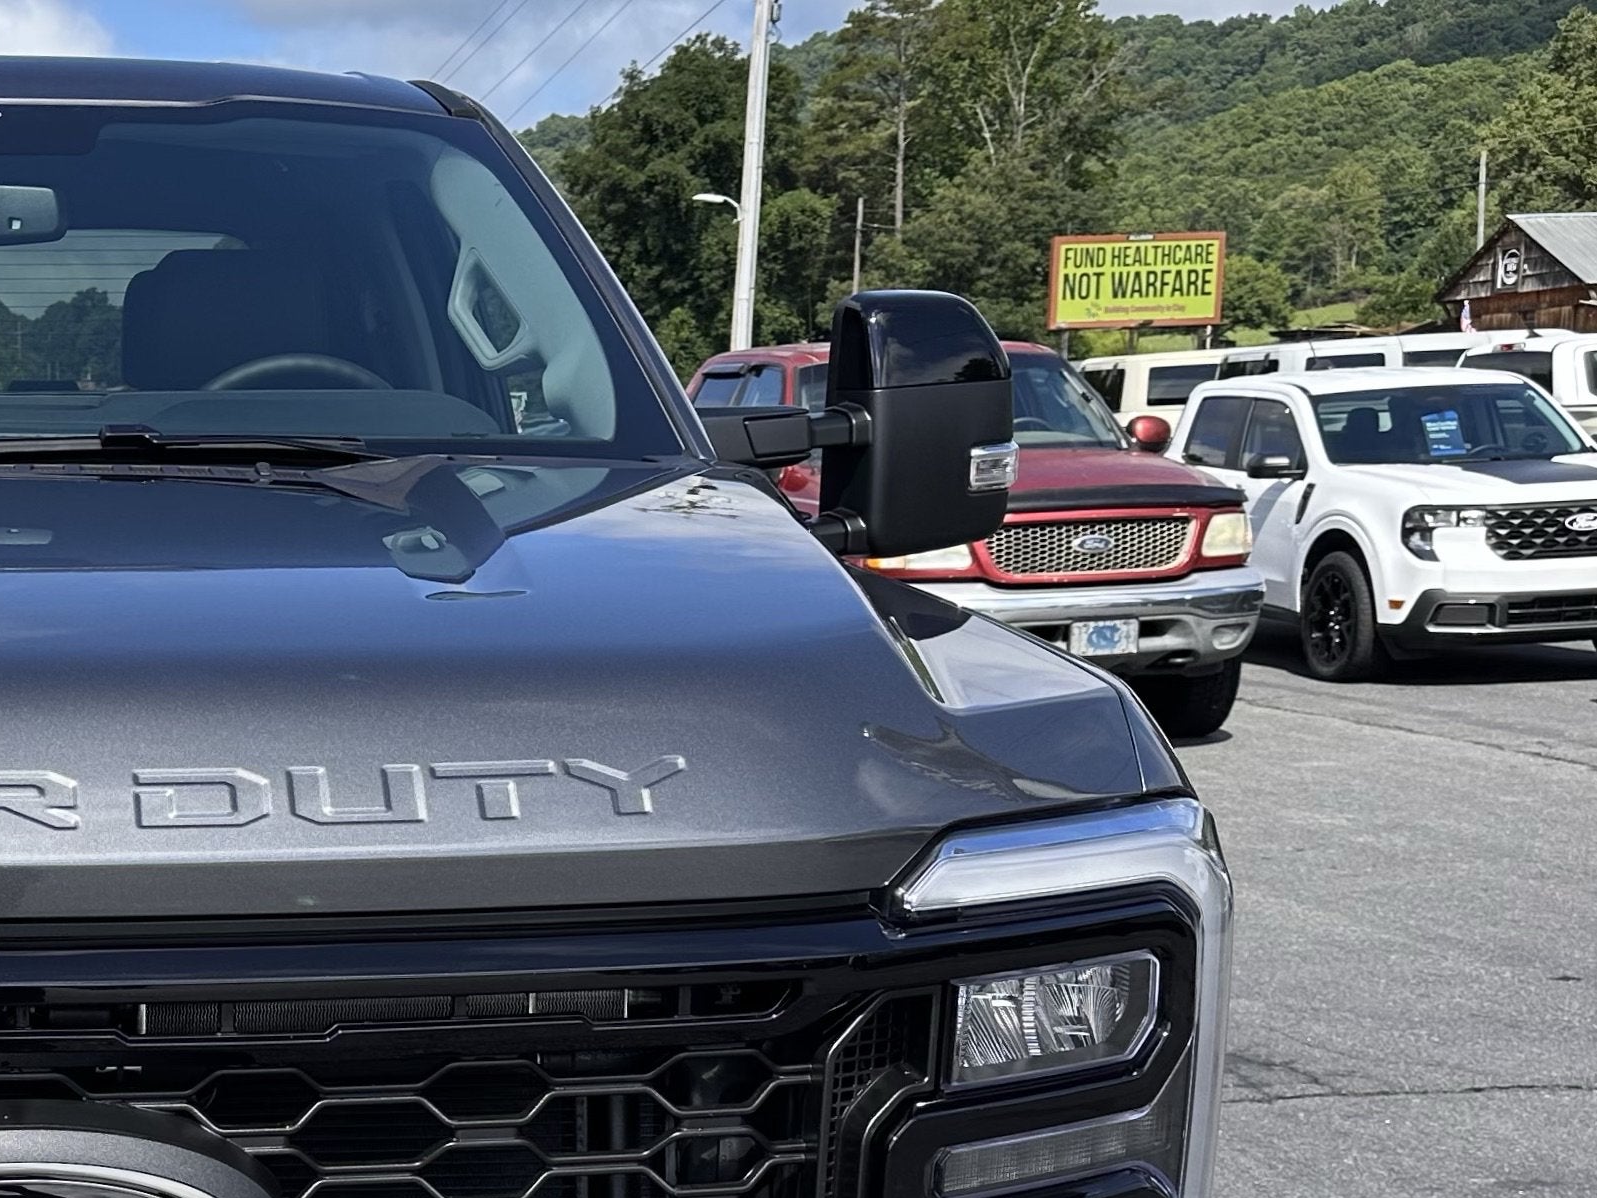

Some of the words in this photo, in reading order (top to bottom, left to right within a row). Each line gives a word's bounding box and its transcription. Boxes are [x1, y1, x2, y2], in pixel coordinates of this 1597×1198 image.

[1063, 246, 1106, 269] FUND
[1110, 243, 1215, 267] HEALTHCARE
[1062, 271, 1106, 300] NOT
[1111, 268, 1214, 299] WARFARE
[132, 754, 687, 829] DUTY
